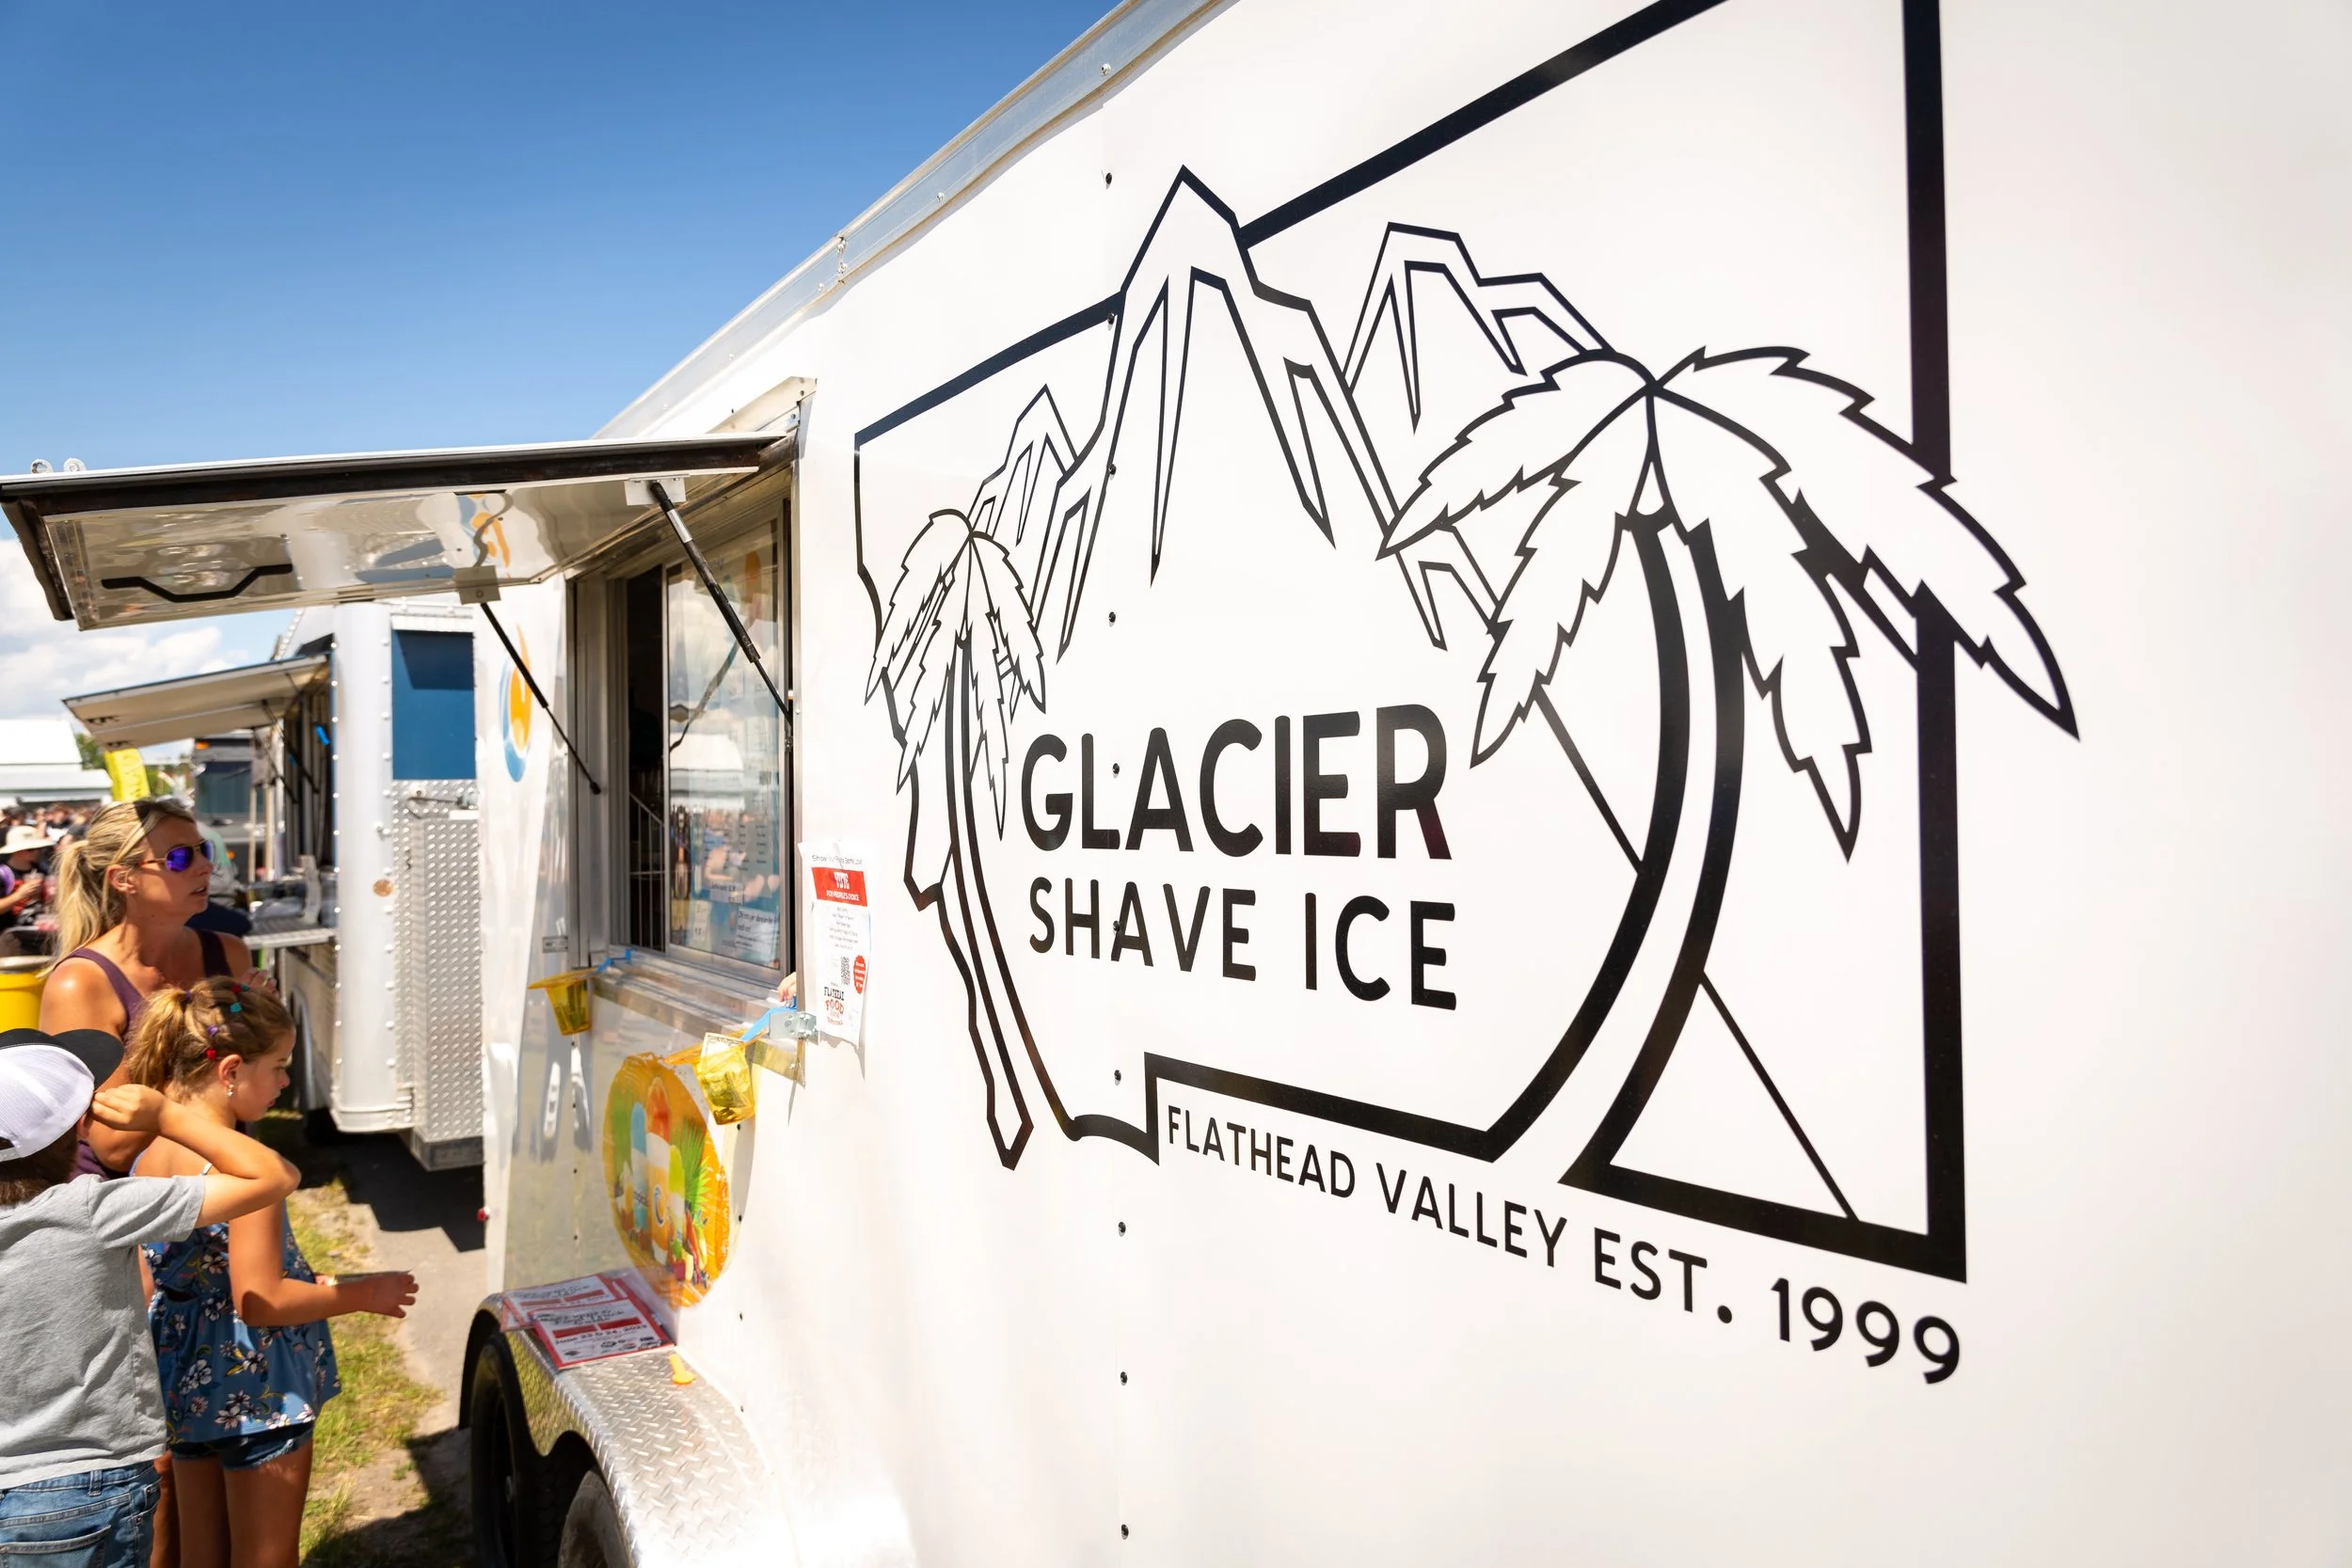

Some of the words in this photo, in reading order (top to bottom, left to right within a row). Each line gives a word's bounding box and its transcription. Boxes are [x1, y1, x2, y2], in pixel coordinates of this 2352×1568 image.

[1022, 704, 1453, 861] GLACIER
[825, 998, 844, 1015] FOOD
[1029, 877, 1257, 982] SHAVE
[1305, 892, 1457, 1011] ICE
[1168, 1104, 1357, 1198] FLATHEAD
[1376, 1162, 1567, 1268] VALLEY
[1594, 1227, 1734, 1324] EST.
[1771, 1276, 1962, 1385] 1999
